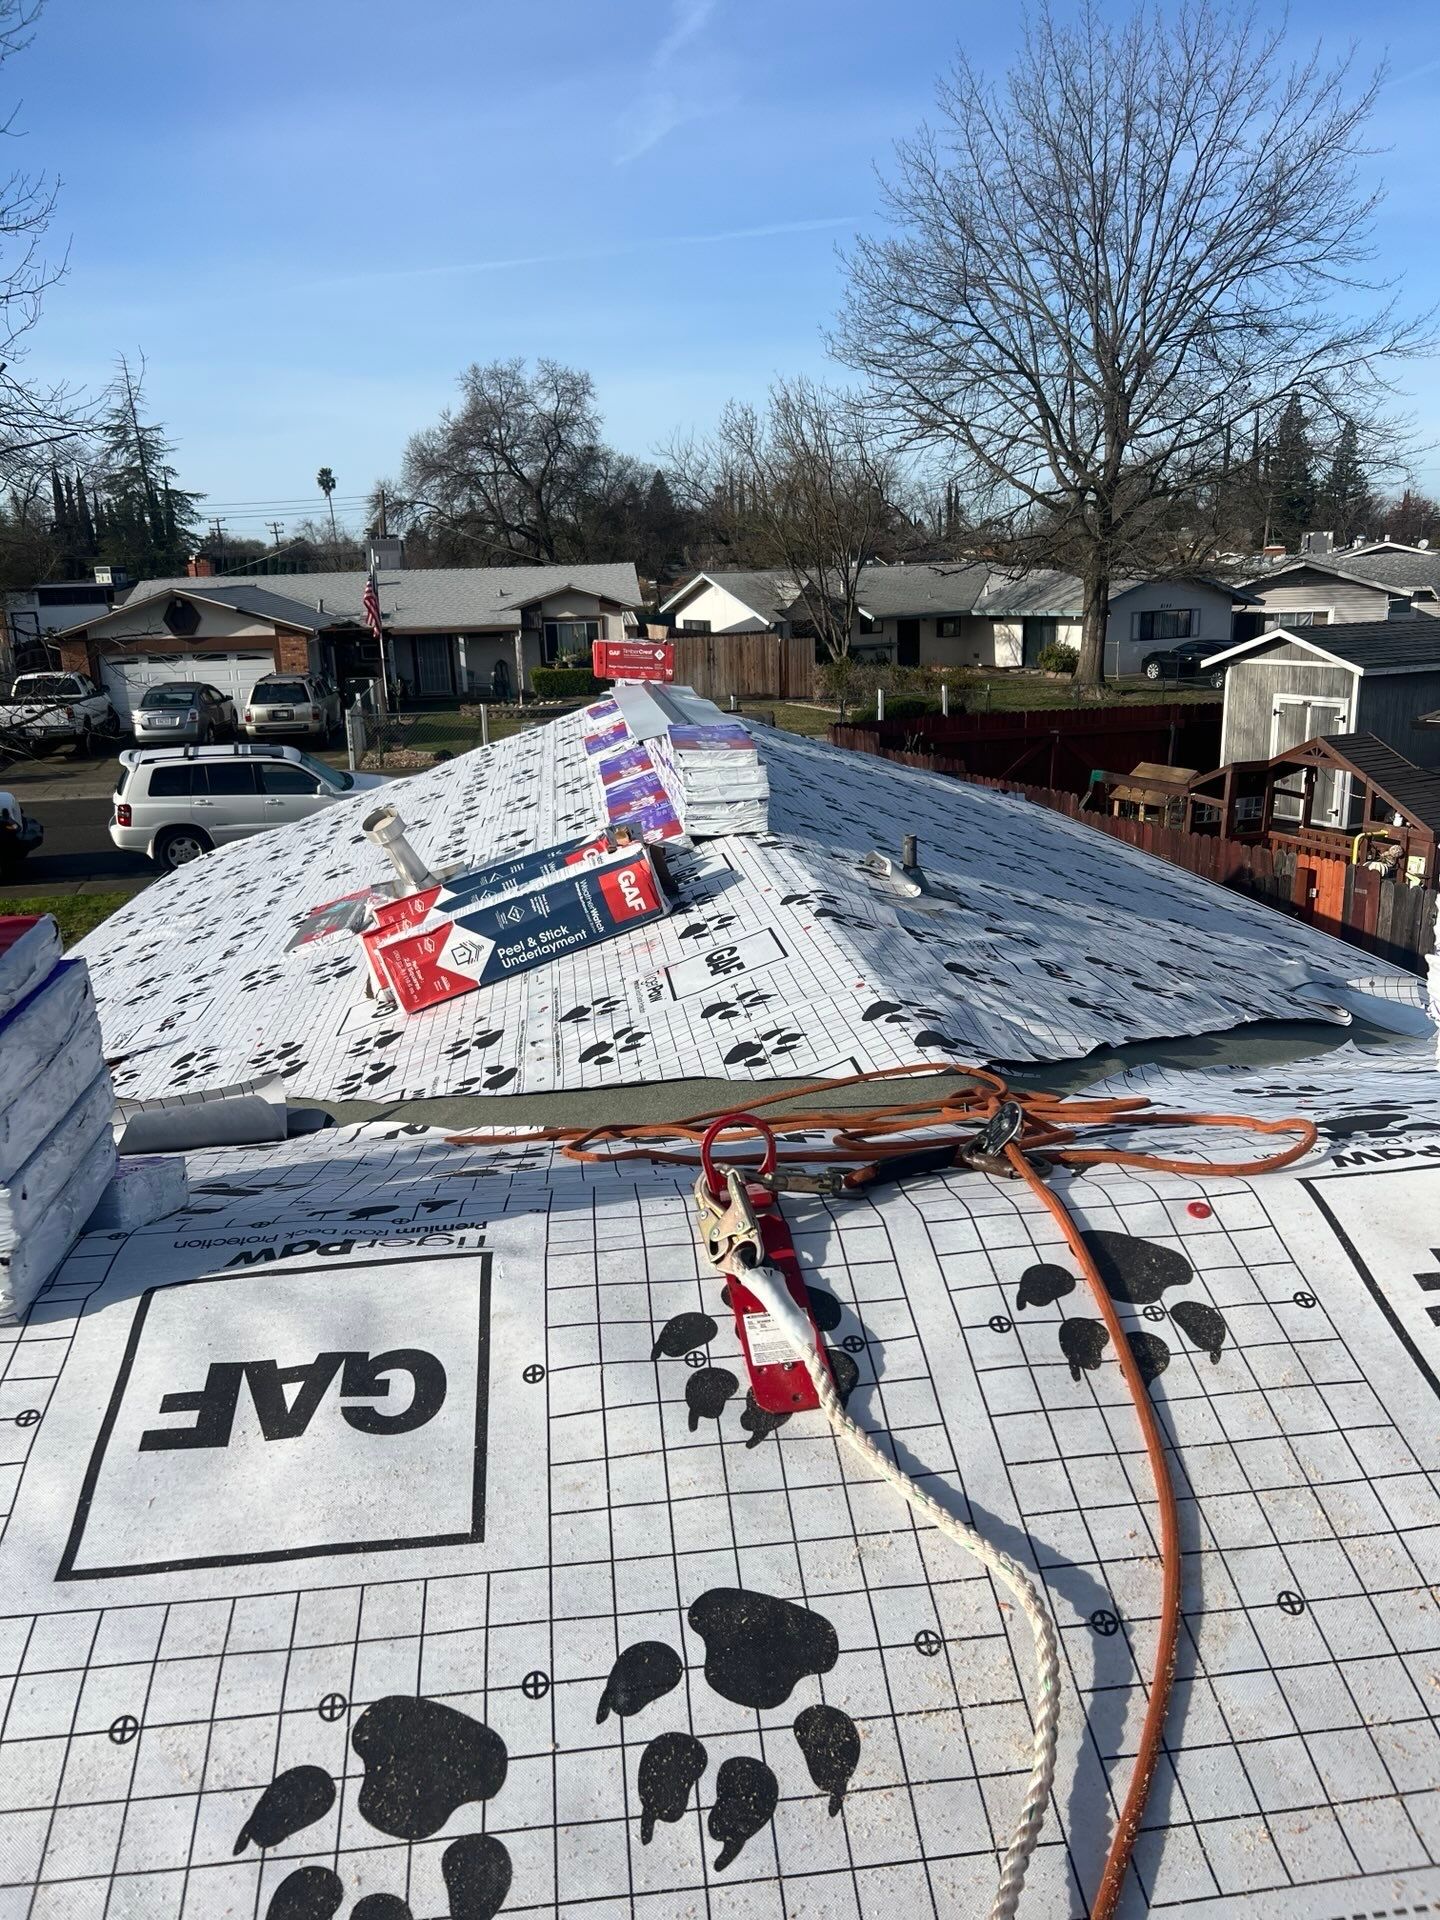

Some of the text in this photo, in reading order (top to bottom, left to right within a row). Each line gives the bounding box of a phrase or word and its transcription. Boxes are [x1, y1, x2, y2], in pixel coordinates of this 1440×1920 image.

[579, 879, 605, 932] WeatherWatch
[617, 870, 646, 912] GAF
[497, 925, 570, 959] Peel & Stick
[501, 929, 588, 969] Underlayment
[407, 967, 422, 990] Squares
[705, 946, 746, 977] GAF
[174, 1220, 488, 1249] Premium Roof Deck Protection
[138, 1348, 447, 1452] GAF
